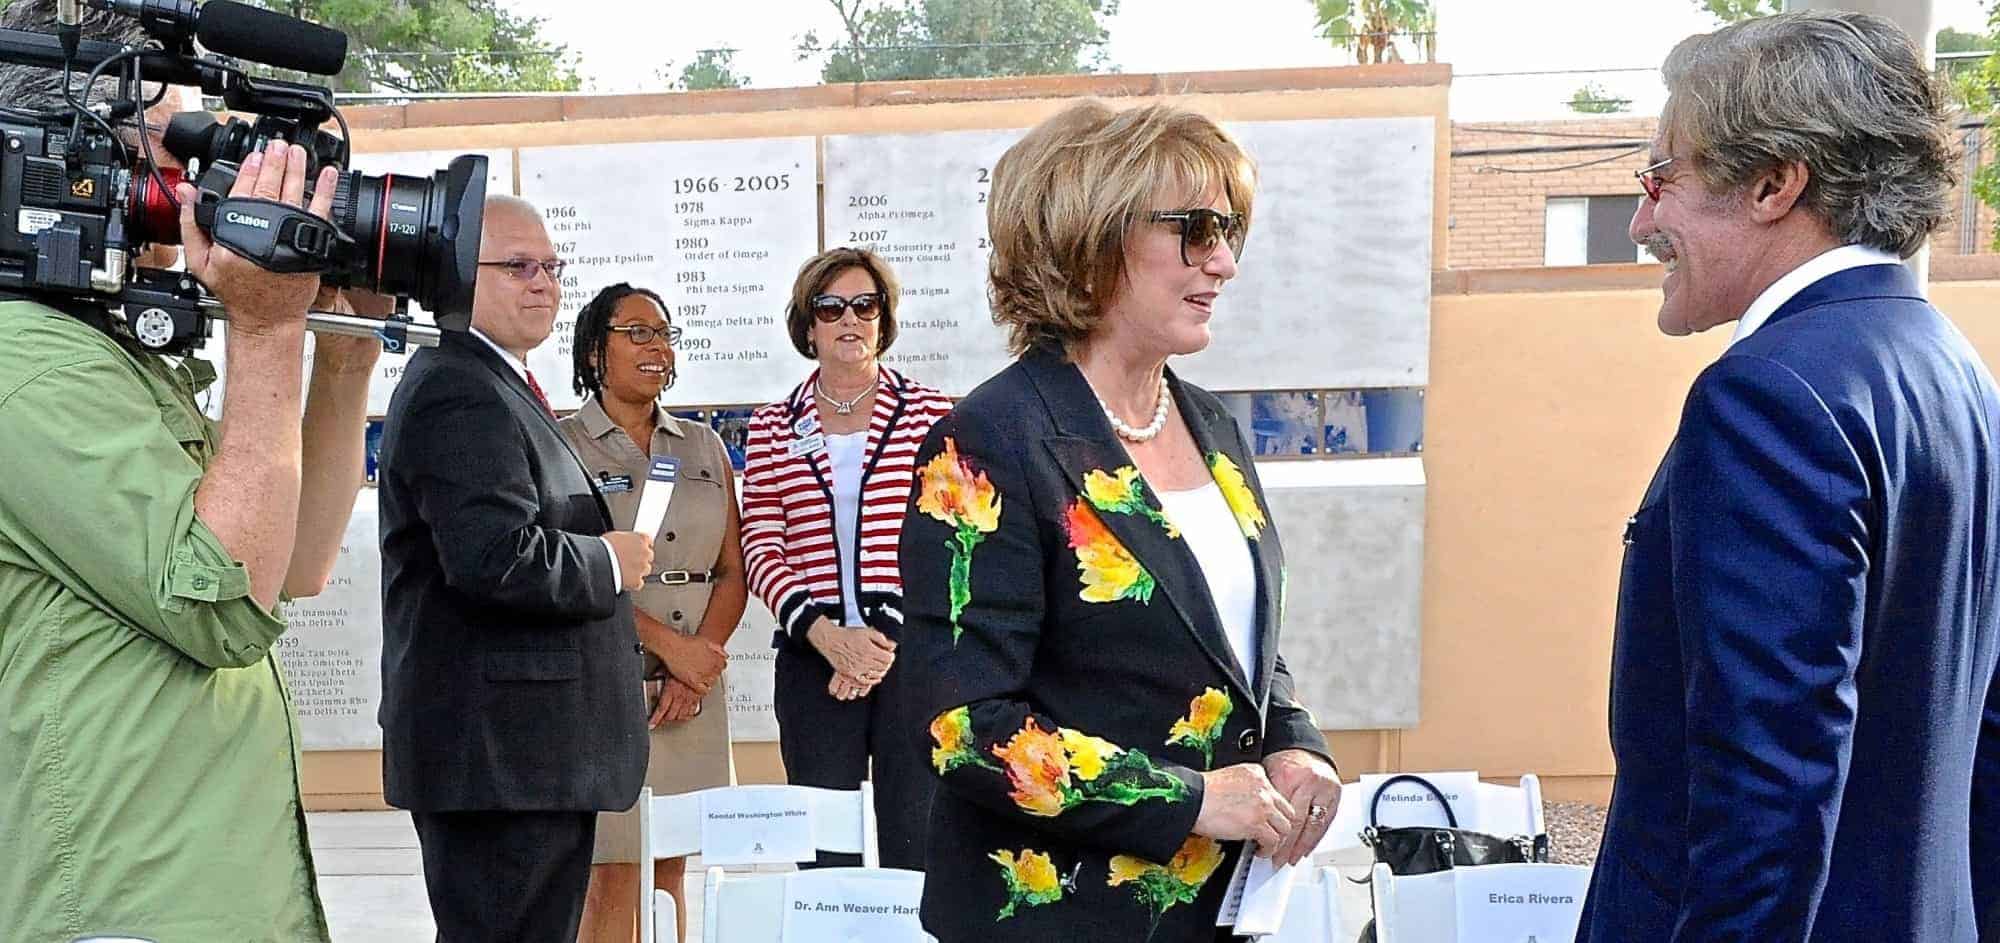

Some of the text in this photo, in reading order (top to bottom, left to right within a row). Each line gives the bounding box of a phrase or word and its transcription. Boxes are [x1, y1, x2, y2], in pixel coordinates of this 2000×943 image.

[673, 177, 719, 194] 1966
[734, 174, 789, 192] 2005
[848, 194, 888, 207] 2006
[545, 206, 576, 219] 1966
[674, 201, 704, 214] 1978
[226, 212, 269, 228] Canon
[858, 210, 886, 220] Alpha
[901, 209, 935, 221] Omega
[389, 222, 416, 234] 17-120
[574, 221, 592, 231] Phi
[683, 216, 752, 228] Sigma Kappa
[848, 230, 888, 242] 2007
[553, 241, 577, 253] 967
[675, 237, 709, 249] 1980
[937, 242, 956, 250] and
[578, 255, 611, 266] Kappa
[684, 250, 769, 261] Order of Omega
[676, 271, 706, 283] 1983
[685, 285, 703, 294] Phi
[732, 284, 764, 295] Sigma
[920, 287, 950, 297] Sigma
[677, 304, 706, 316] 1987
[686, 316, 774, 329] Omega Delta Phi
[930, 319, 959, 330] Alpha
[679, 338, 711, 350] 1990
[688, 350, 768, 361] Zeta Tau Alpha
[897, 354, 927, 364] Sigma
[276, 637, 299, 648] 959
[288, 679, 306, 687] elta
[1382, 793, 1423, 802] Melinda
[1489, 893, 1573, 904] Erica Rivera
[794, 900, 812, 911] Dr.
[815, 901, 839, 913] Ann
[843, 903, 889, 914] Weaver
